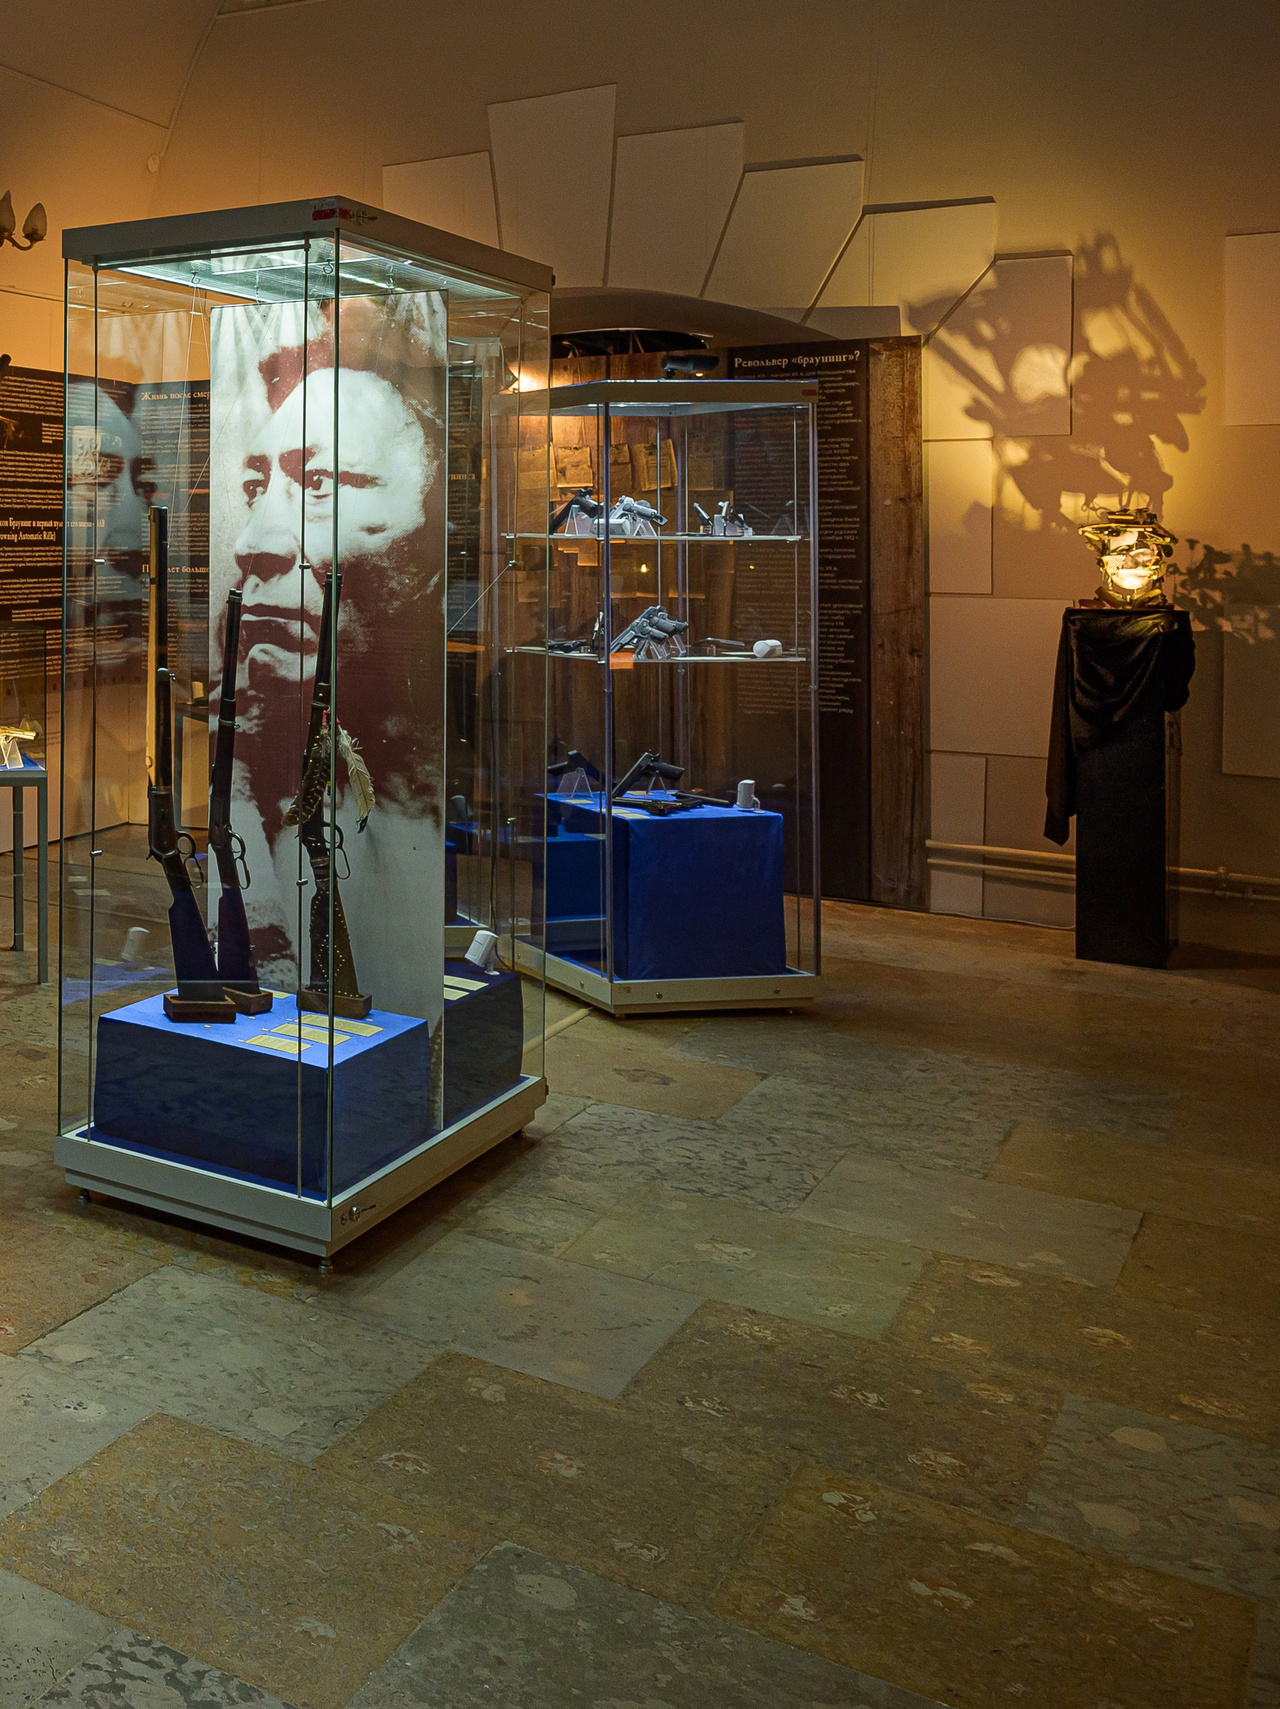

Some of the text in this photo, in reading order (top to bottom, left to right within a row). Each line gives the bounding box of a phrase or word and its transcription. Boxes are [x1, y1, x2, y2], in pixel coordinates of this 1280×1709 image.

[734, 357, 789, 370] Револьвер
[141, 391, 169, 402] Жизнь
[192, 391, 211, 402] смер
[9, 517, 32, 530] Браунинг
[18, 531, 42, 541] Automatic
